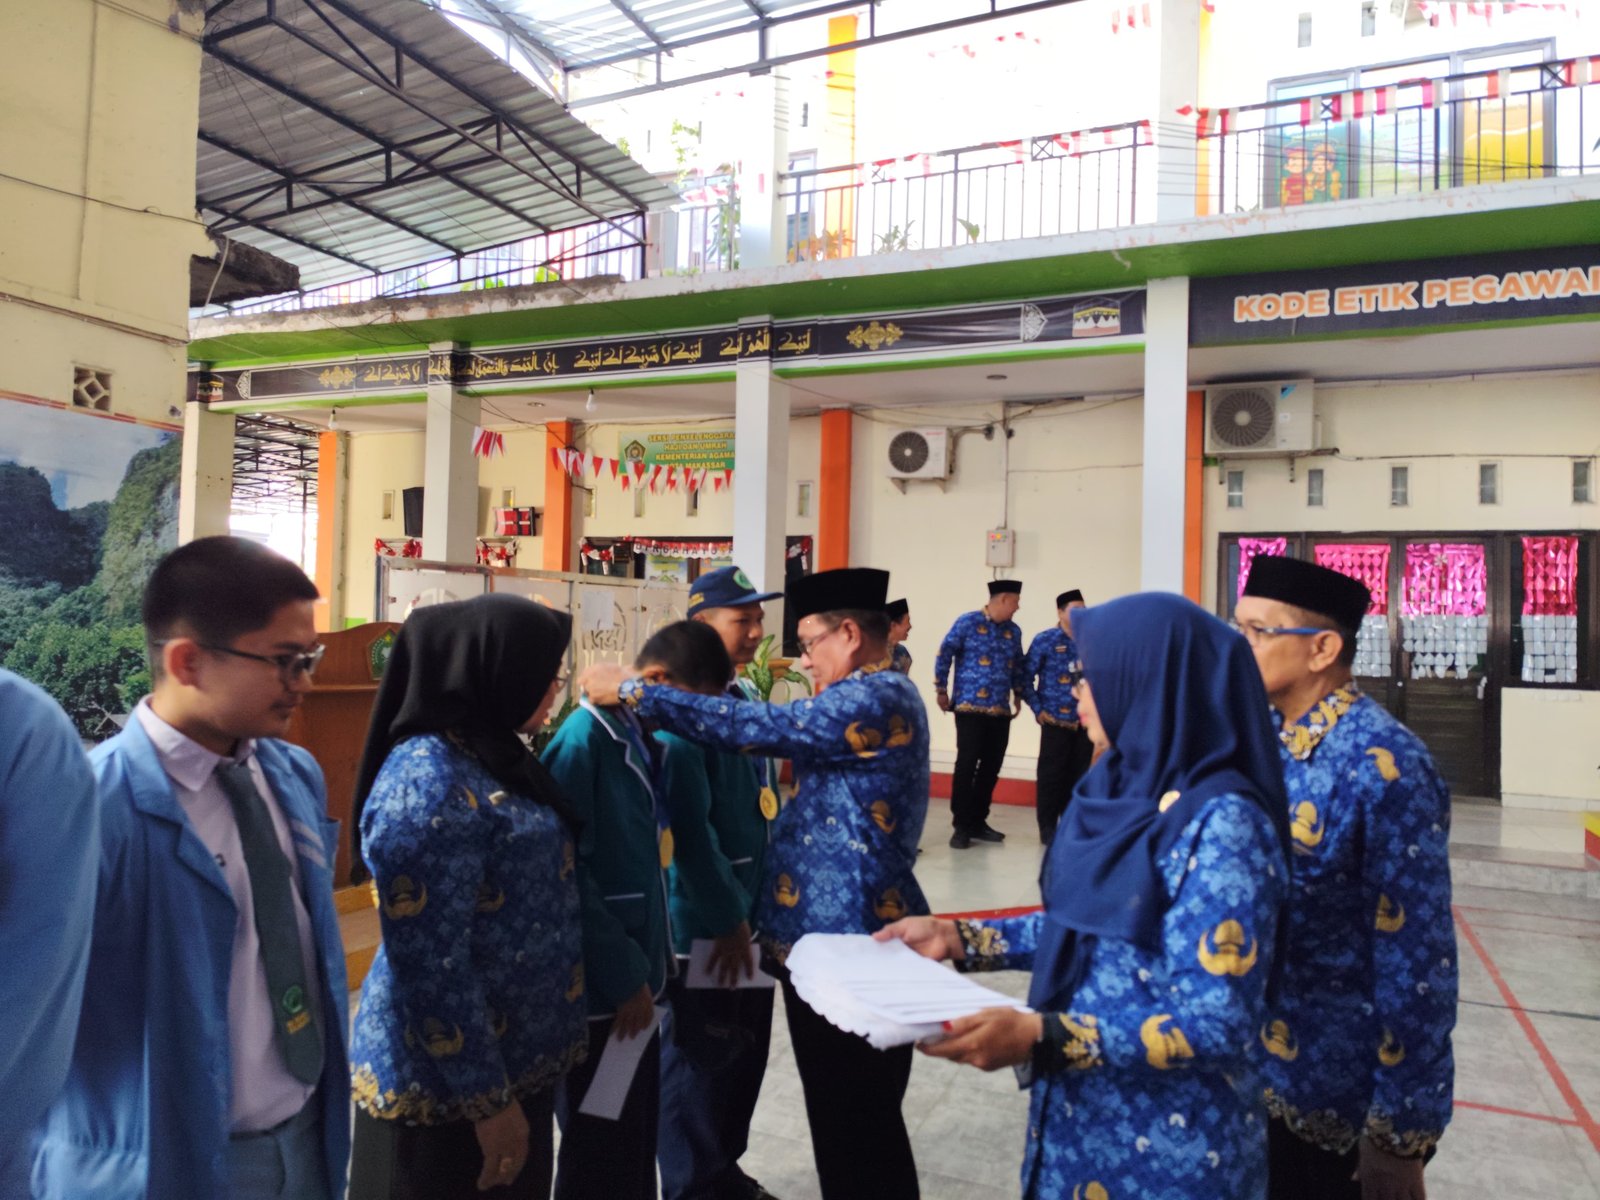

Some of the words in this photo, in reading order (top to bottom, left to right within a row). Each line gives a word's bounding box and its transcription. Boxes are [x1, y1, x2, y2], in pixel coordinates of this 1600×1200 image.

[1234, 289, 1329, 322] KODE
[1335, 281, 1419, 315] ETIK
[1422, 266, 1600, 309] PEGAWAI
[656, 452, 707, 461] KEMENTERIAN
[685, 461, 726, 470] MAKASSAR
